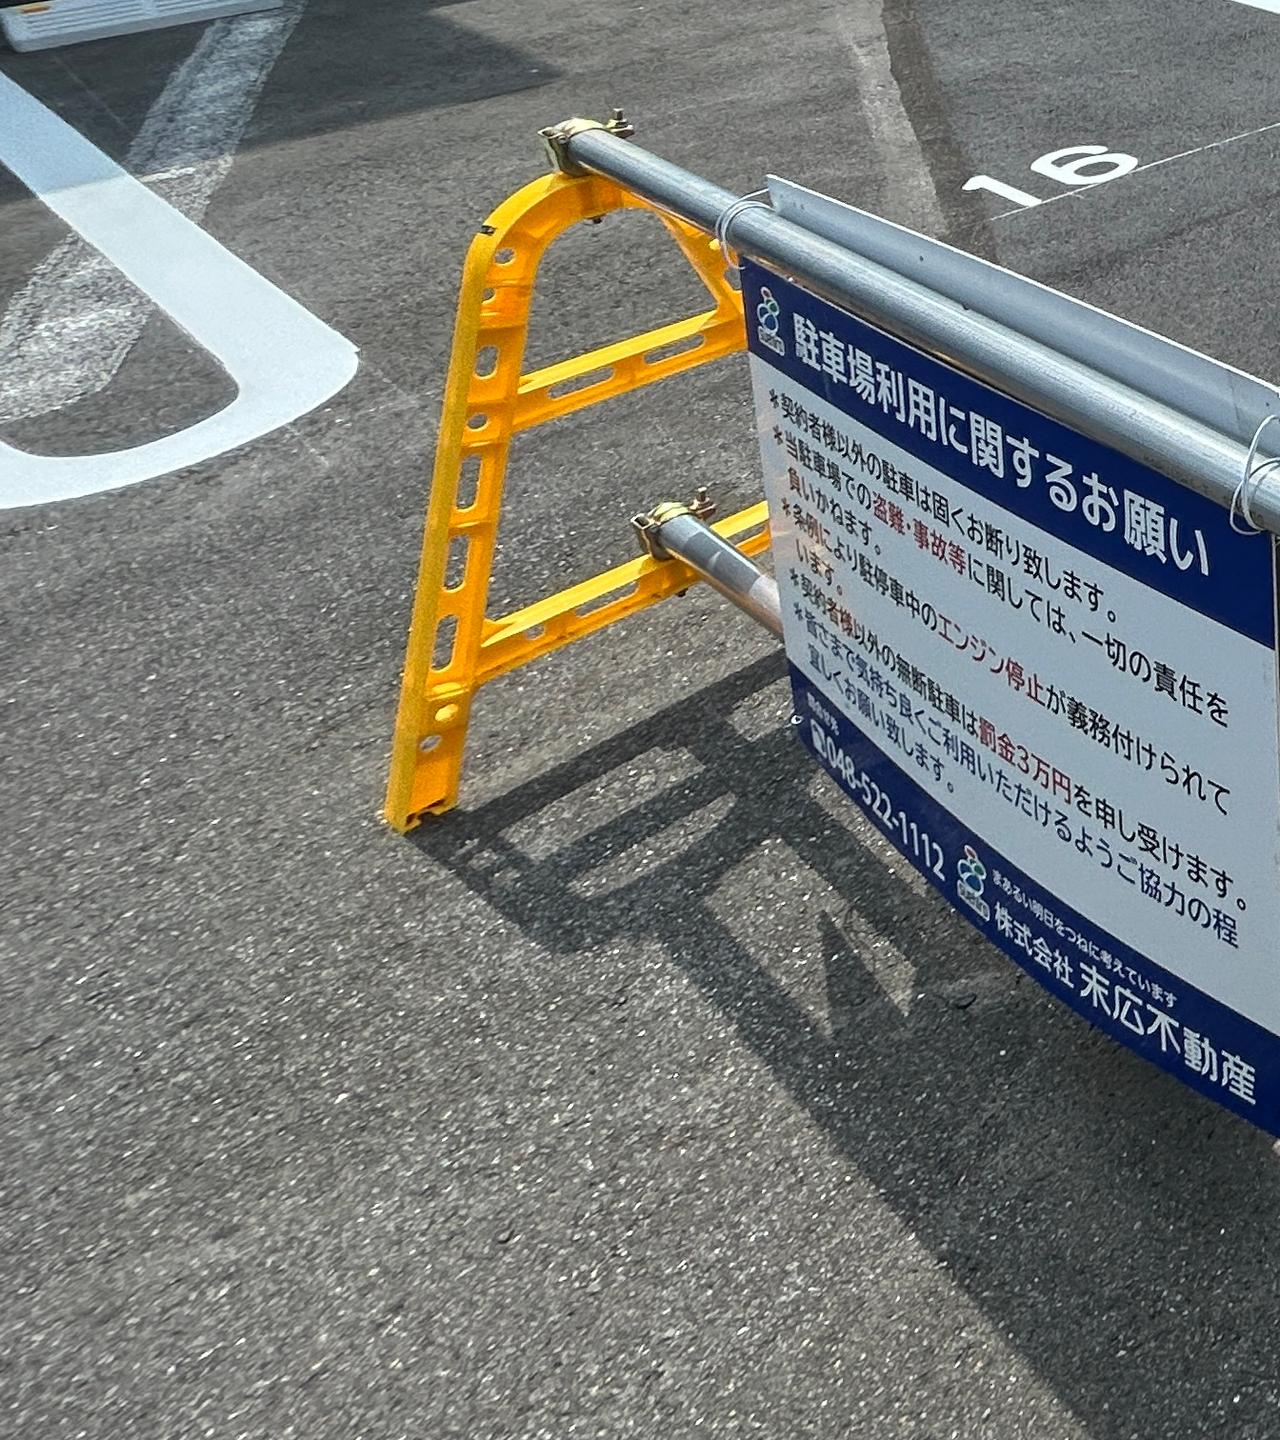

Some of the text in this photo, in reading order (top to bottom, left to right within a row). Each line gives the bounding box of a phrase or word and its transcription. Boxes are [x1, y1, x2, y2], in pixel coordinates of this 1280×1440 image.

[962, 145, 1139, 208] 16
[793, 312, 1209, 576] 駐車場利用に関するお願い
[826, 736, 945, 881] 048-522-1112
[995, 901, 1256, 1105] 株式会社 末広不動産
